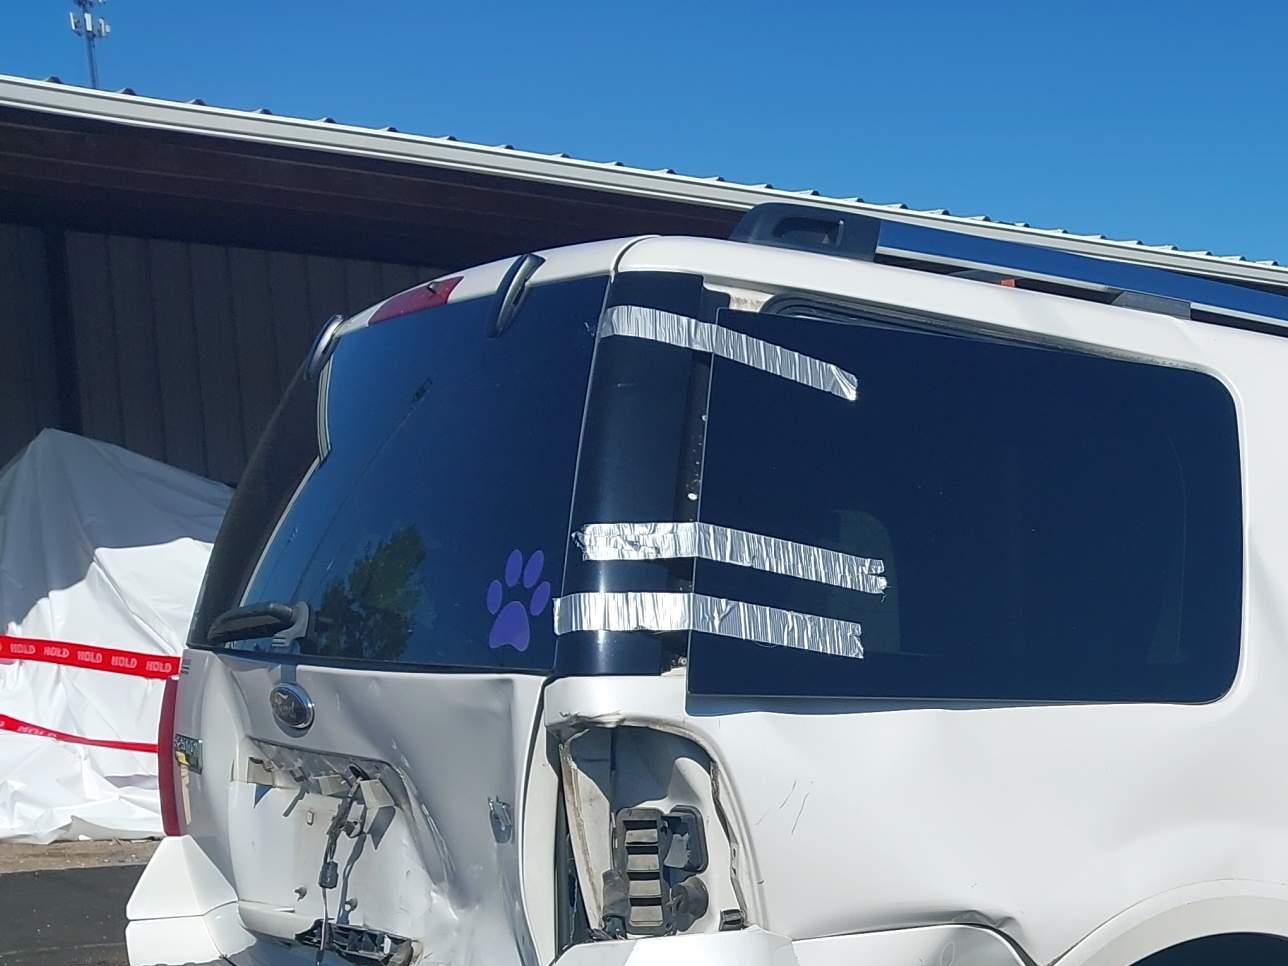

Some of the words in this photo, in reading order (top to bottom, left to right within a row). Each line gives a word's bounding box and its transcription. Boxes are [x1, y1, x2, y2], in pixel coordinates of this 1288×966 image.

[10, 643, 36, 655] HOLD
[43, 646, 70, 658] HOLD
[77, 650, 103, 663] HOLD
[111, 655, 137, 669] HOLD
[146, 660, 172, 673] HOLD
